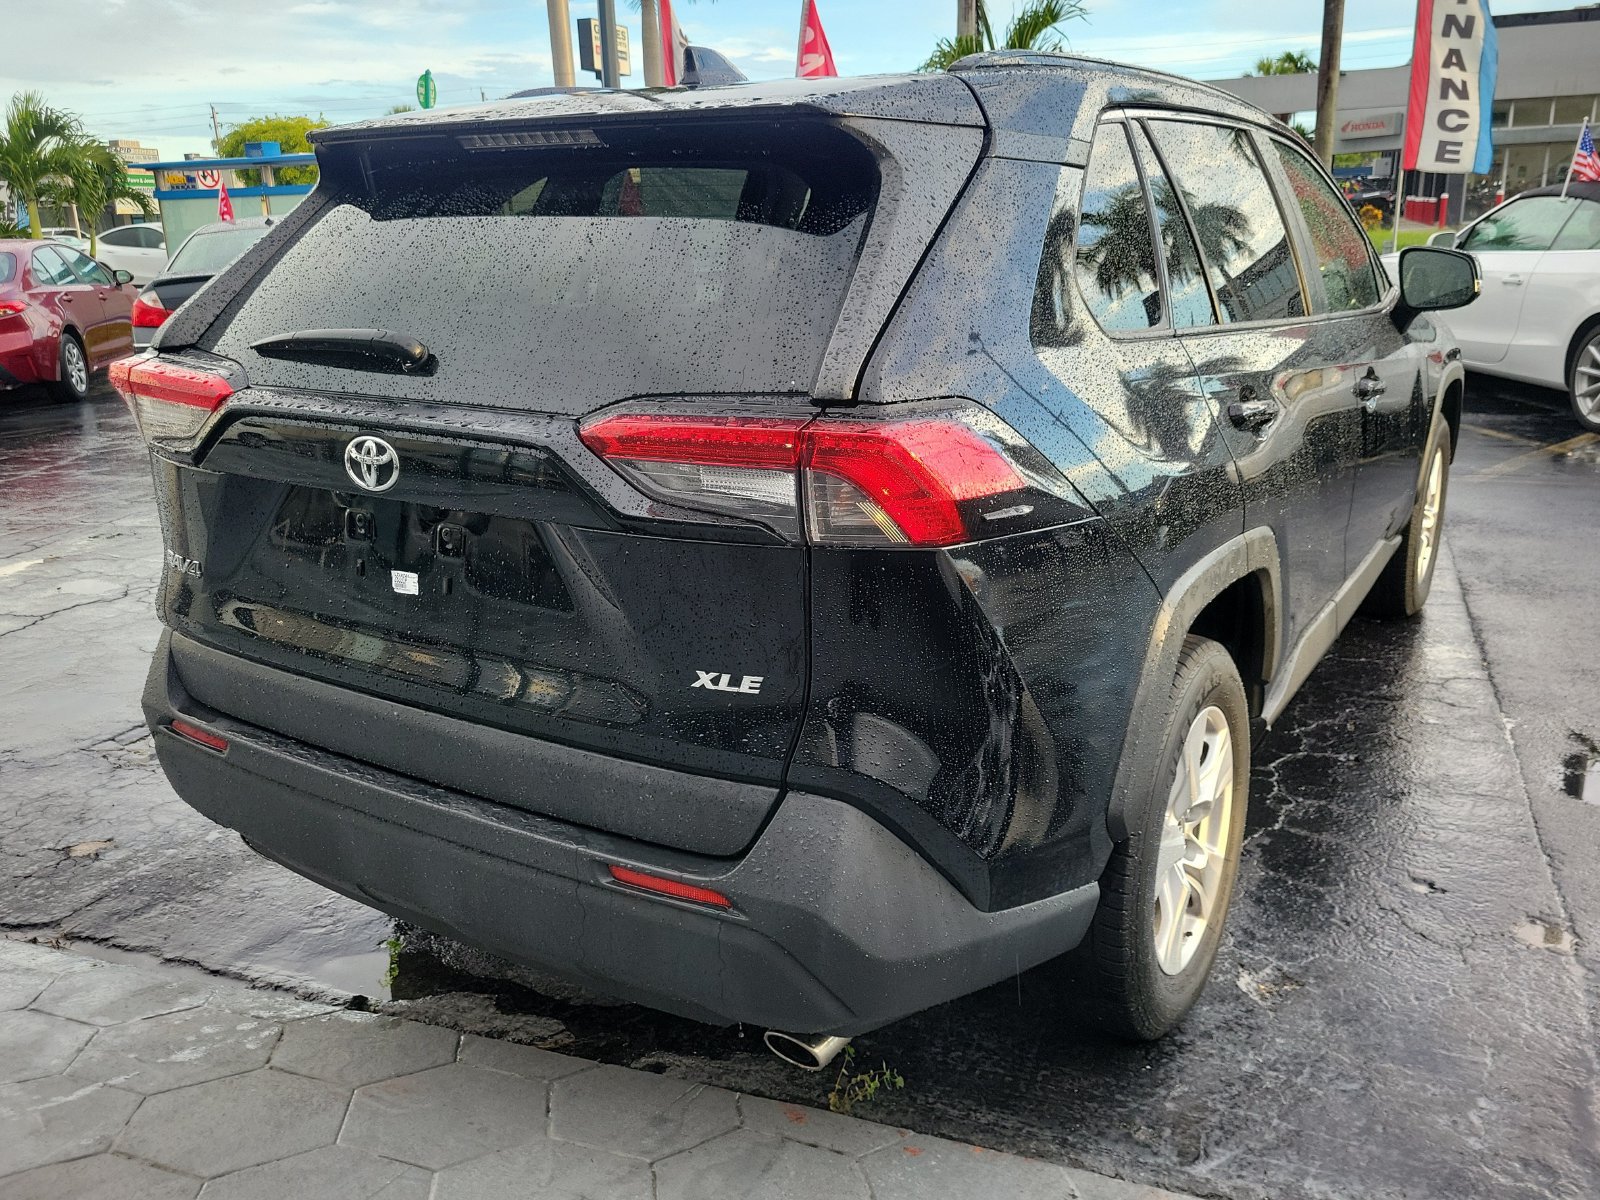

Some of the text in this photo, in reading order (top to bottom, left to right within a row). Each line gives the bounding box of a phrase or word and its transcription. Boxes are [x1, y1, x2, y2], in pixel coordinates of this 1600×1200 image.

[1434, 0, 1475, 164] NANCE
[1351, 121, 1386, 132] HONDA
[691, 670, 764, 694] XLE
